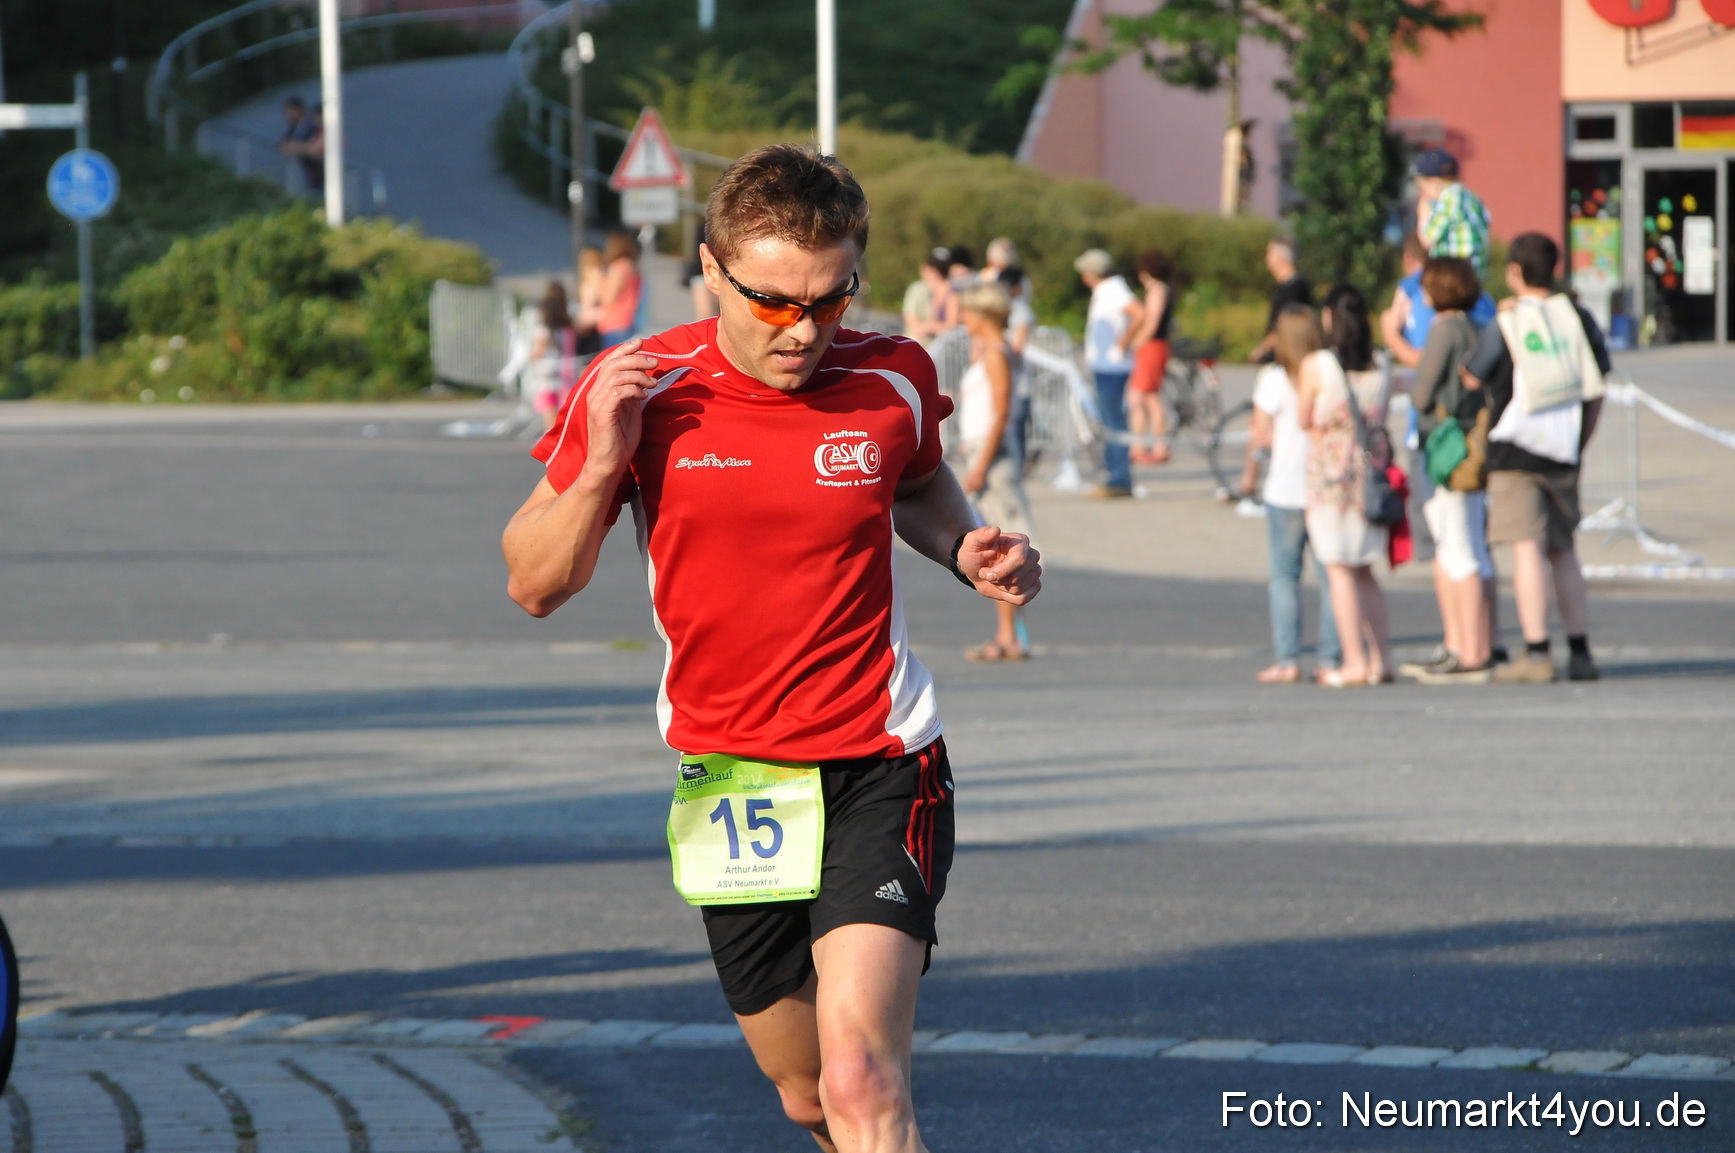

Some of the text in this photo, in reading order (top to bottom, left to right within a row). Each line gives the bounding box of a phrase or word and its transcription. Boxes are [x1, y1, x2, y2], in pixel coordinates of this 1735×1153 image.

[823, 430, 868, 440] Laufteam
[832, 443, 858, 463] ASV
[816, 478, 853, 487] Kraftsport
[709, 798, 784, 859] 15
[725, 864, 776, 874] Arthur Andor
[717, 878, 781, 889] ASV Neumarkt e.V.
[875, 890, 909, 905] adidas
